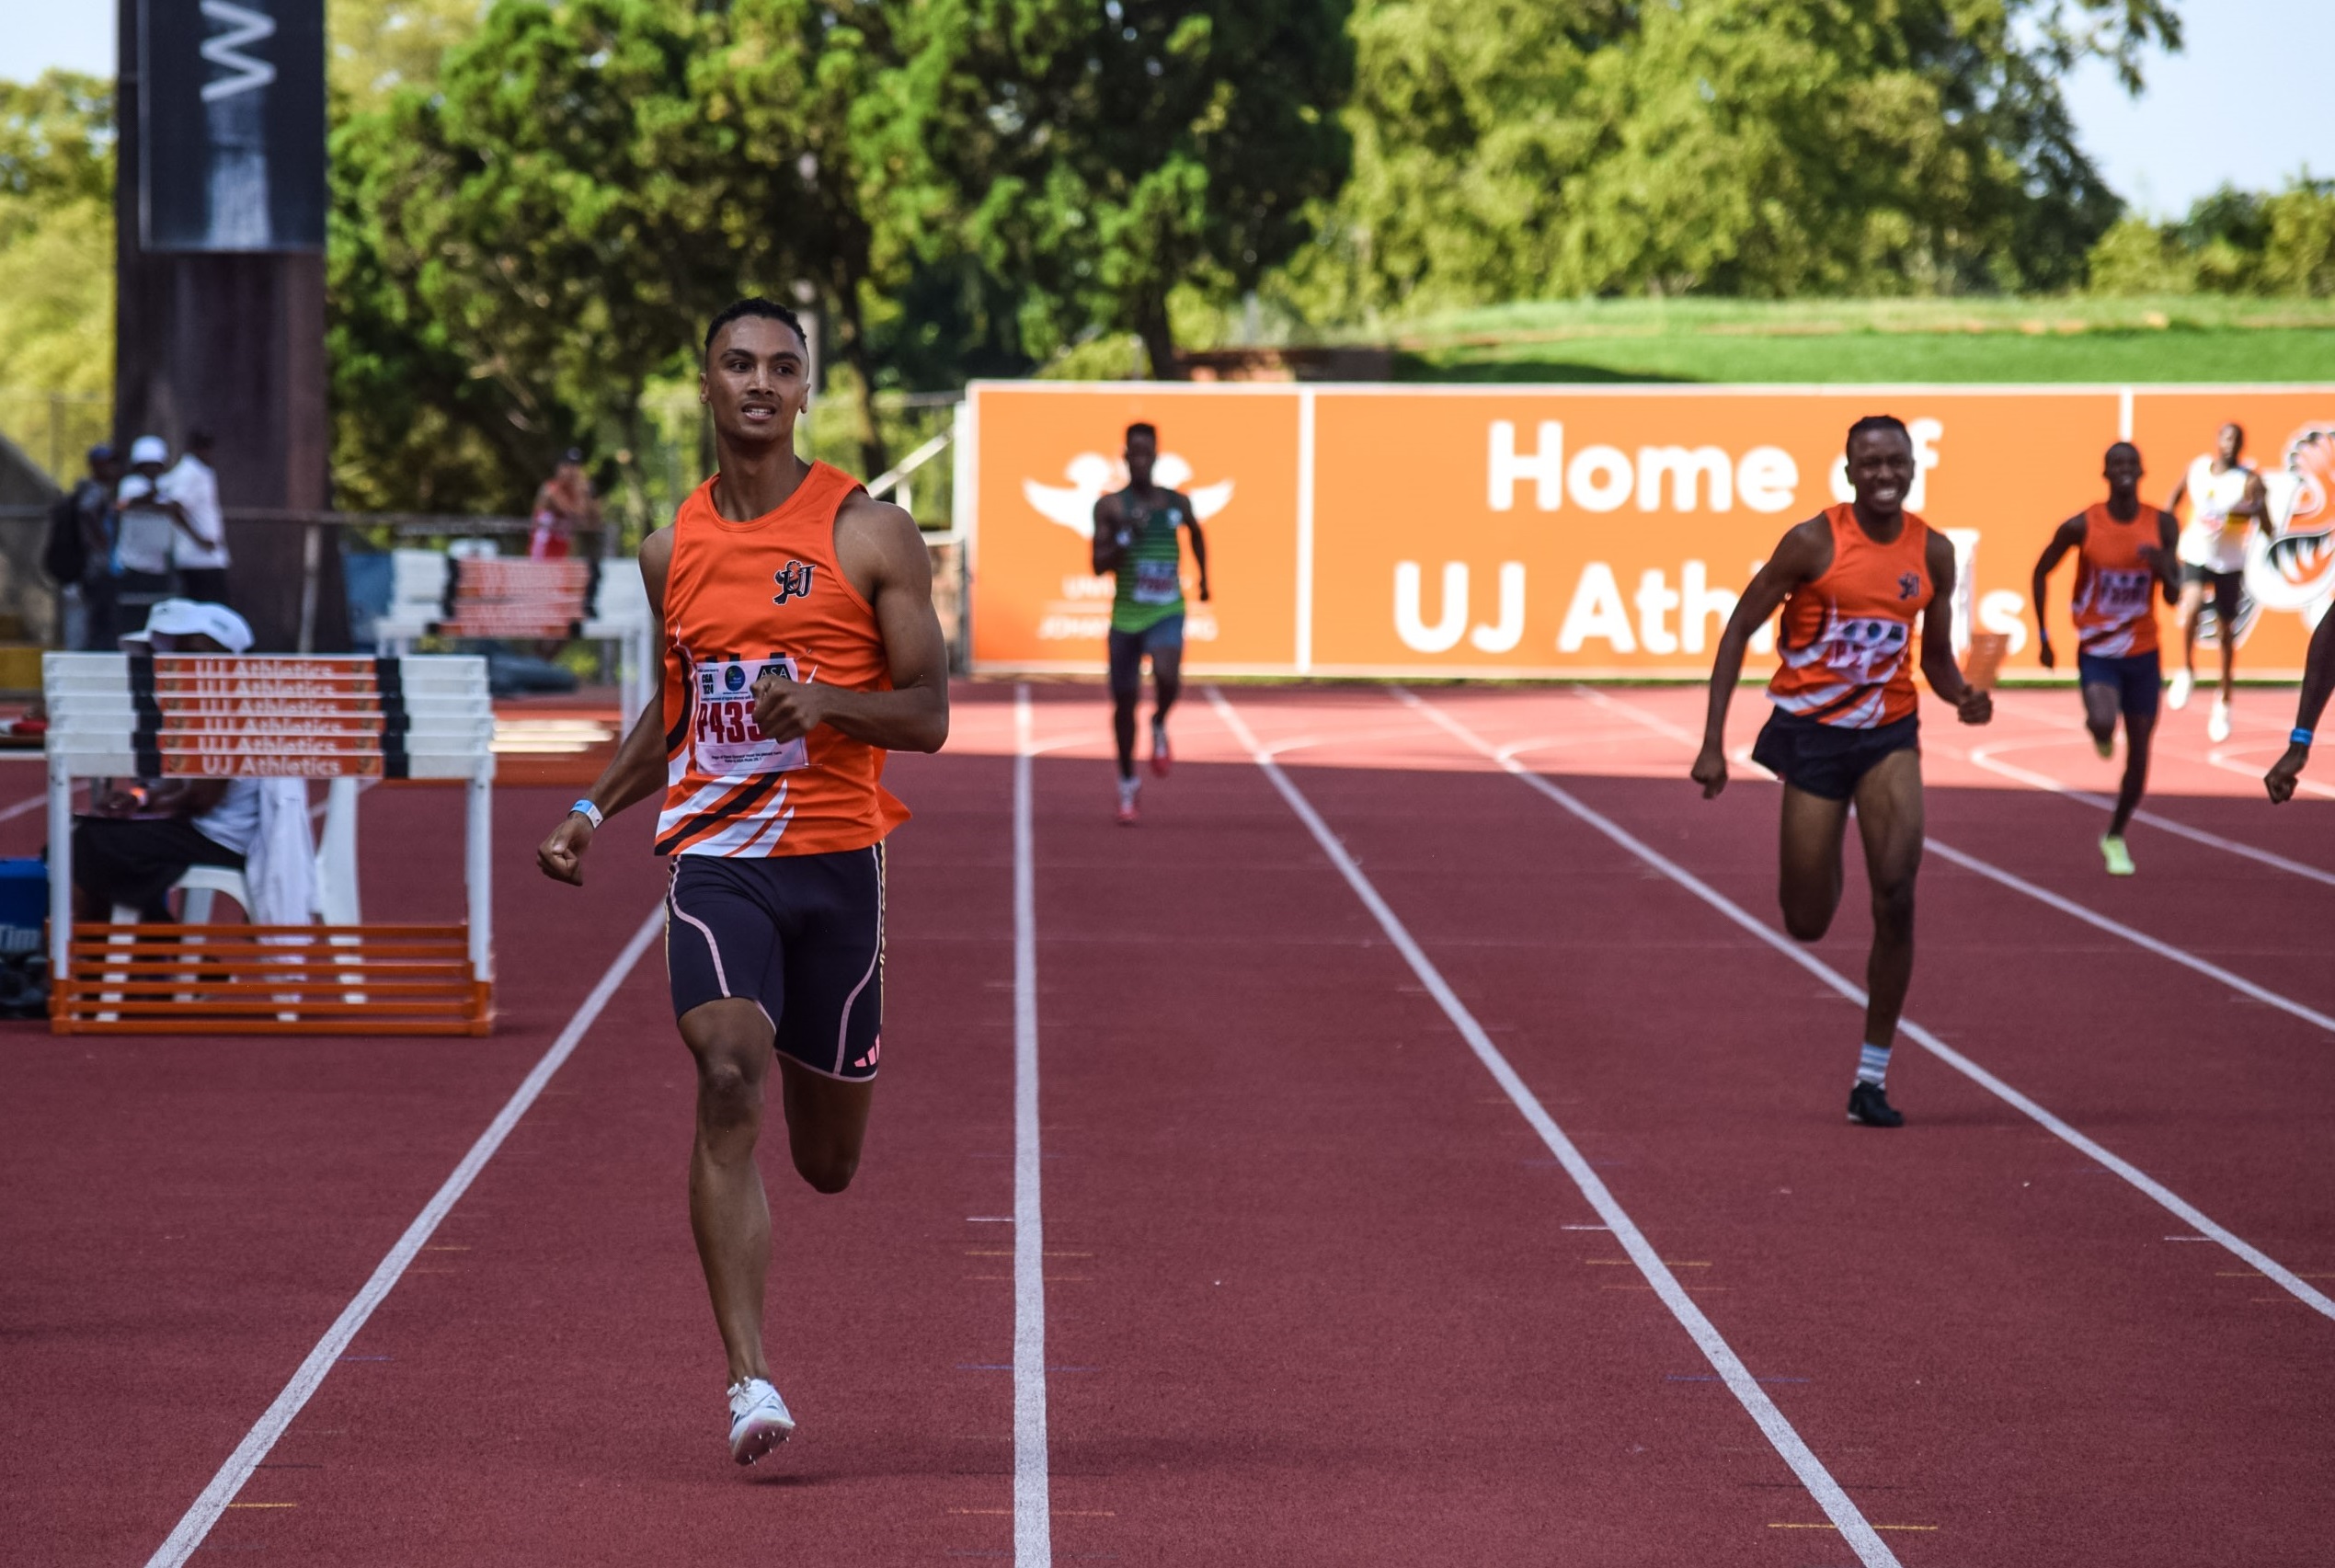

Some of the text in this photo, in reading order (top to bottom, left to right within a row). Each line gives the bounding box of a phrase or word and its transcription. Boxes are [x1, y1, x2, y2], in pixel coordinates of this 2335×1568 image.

[1488, 420, 1798, 512] Home
[1394, 561, 1525, 653] UJ
[233, 659, 334, 678] Athletics
[235, 680, 335, 696] Athletics
[237, 698, 338, 715] Athletics
[243, 717, 343, 734] Athletics
[236, 736, 338, 753] Athletics
[201, 756, 341, 775] UJ Athletics
